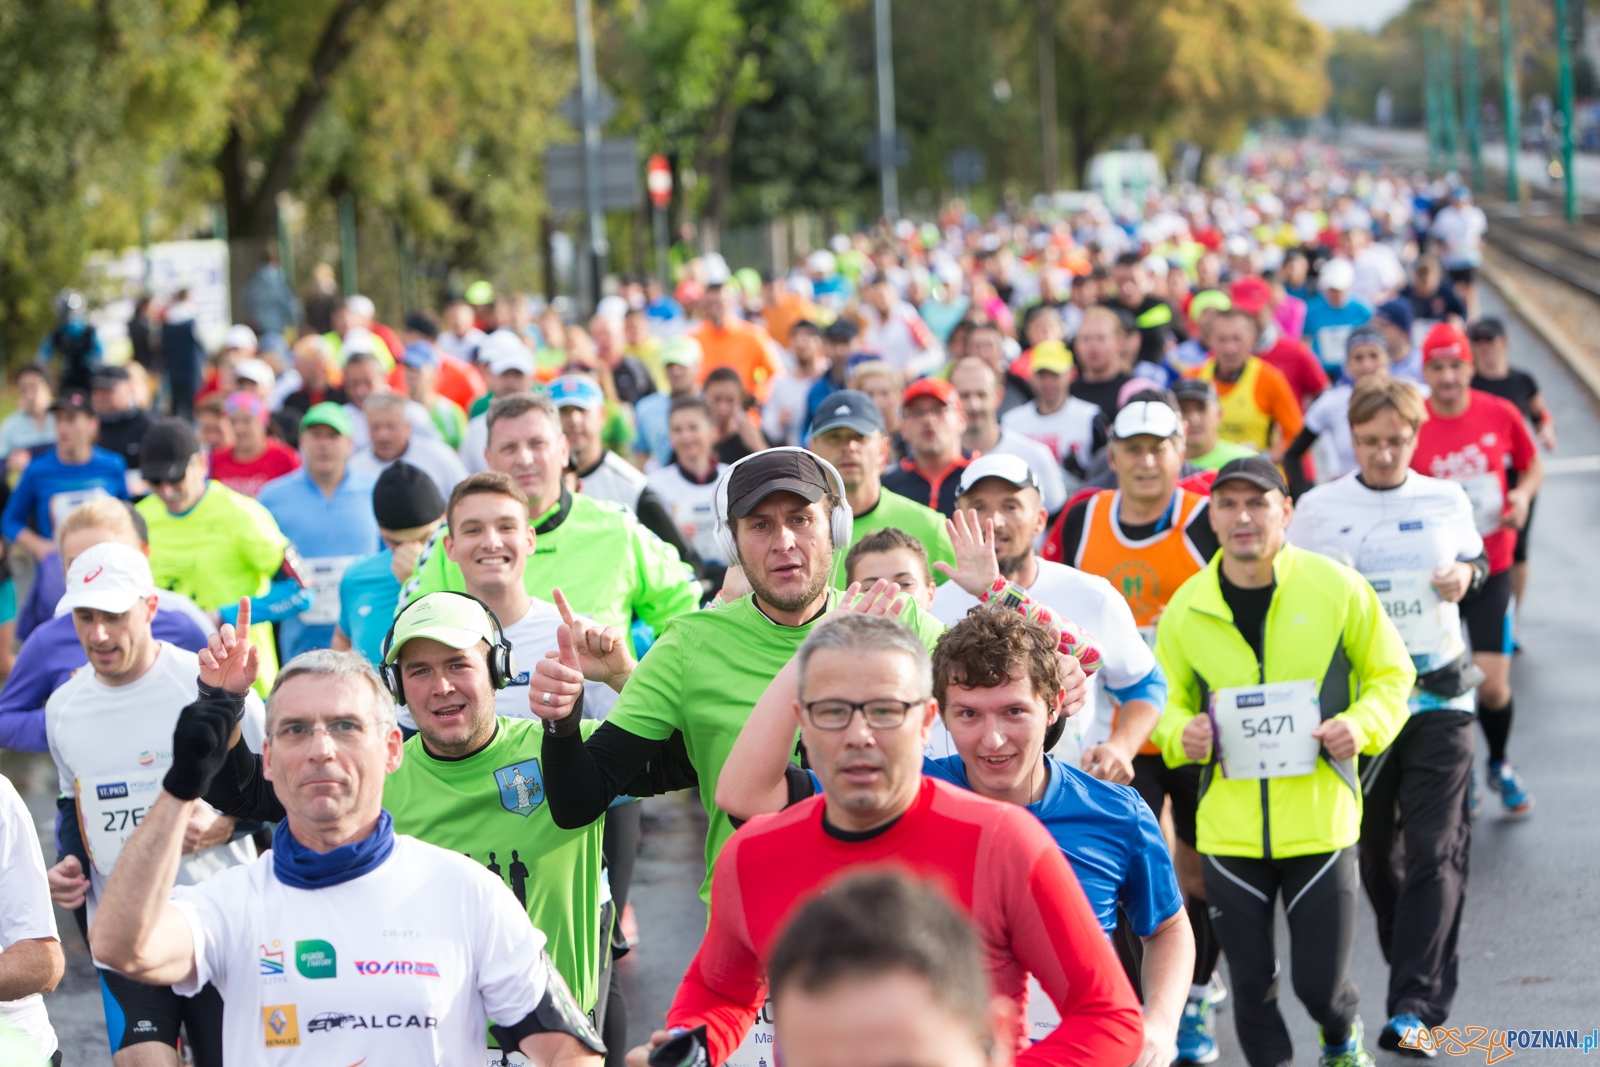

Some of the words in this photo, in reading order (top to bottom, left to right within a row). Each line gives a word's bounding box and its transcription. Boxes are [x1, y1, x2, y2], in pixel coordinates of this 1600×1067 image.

[1241, 714, 1294, 738] 5471
[101, 805, 153, 832] 276
[352, 1014, 438, 1030] ALCAR
